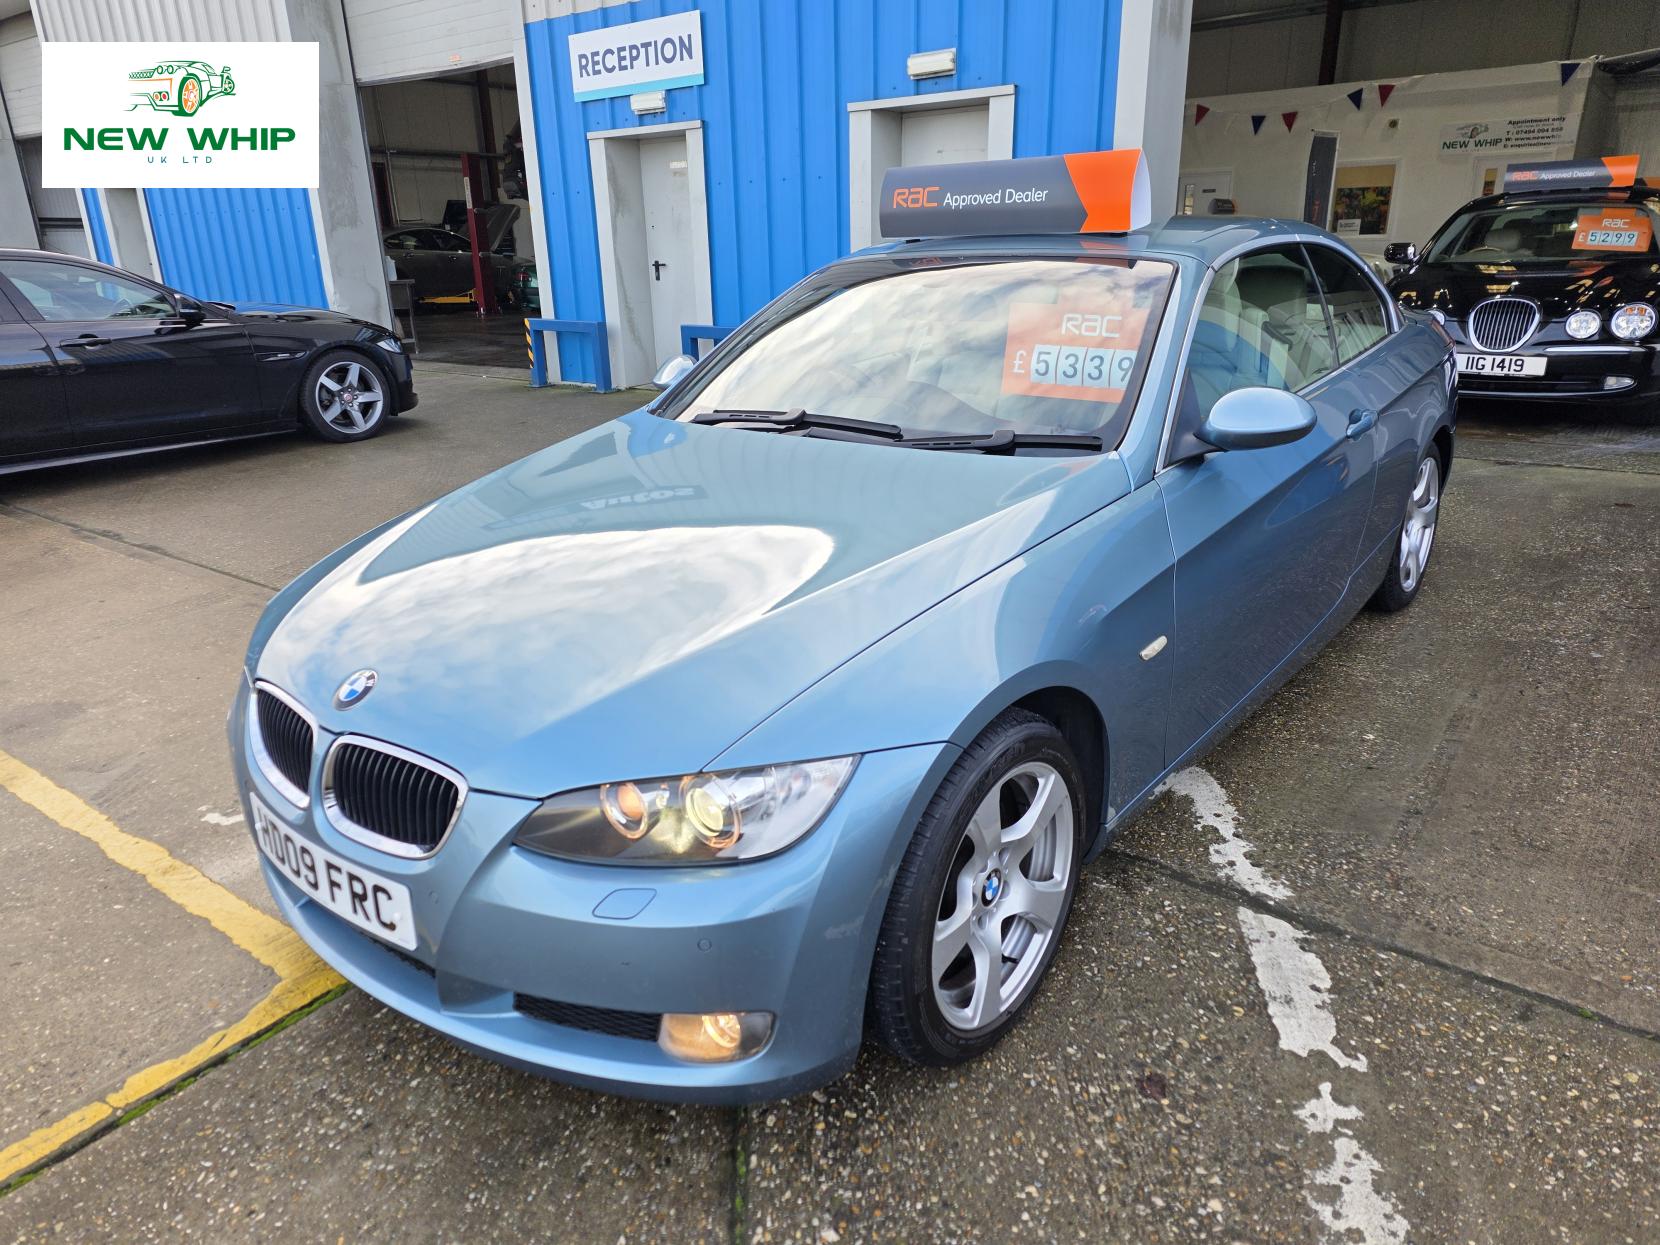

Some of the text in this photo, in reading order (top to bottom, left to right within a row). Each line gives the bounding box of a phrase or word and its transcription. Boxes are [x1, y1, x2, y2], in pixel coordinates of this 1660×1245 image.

[577, 33, 694, 78] RECEPTION
[1442, 138, 1503, 150] NEW WHIP
[1540, 172, 1572, 181] Approved
[1573, 169, 1596, 178] Dealer
[943, 189, 1002, 210] Approved
[1005, 187, 1049, 204] Dealer
[1490, 357, 1525, 373] 1419
[324, 859, 397, 932] FRC
